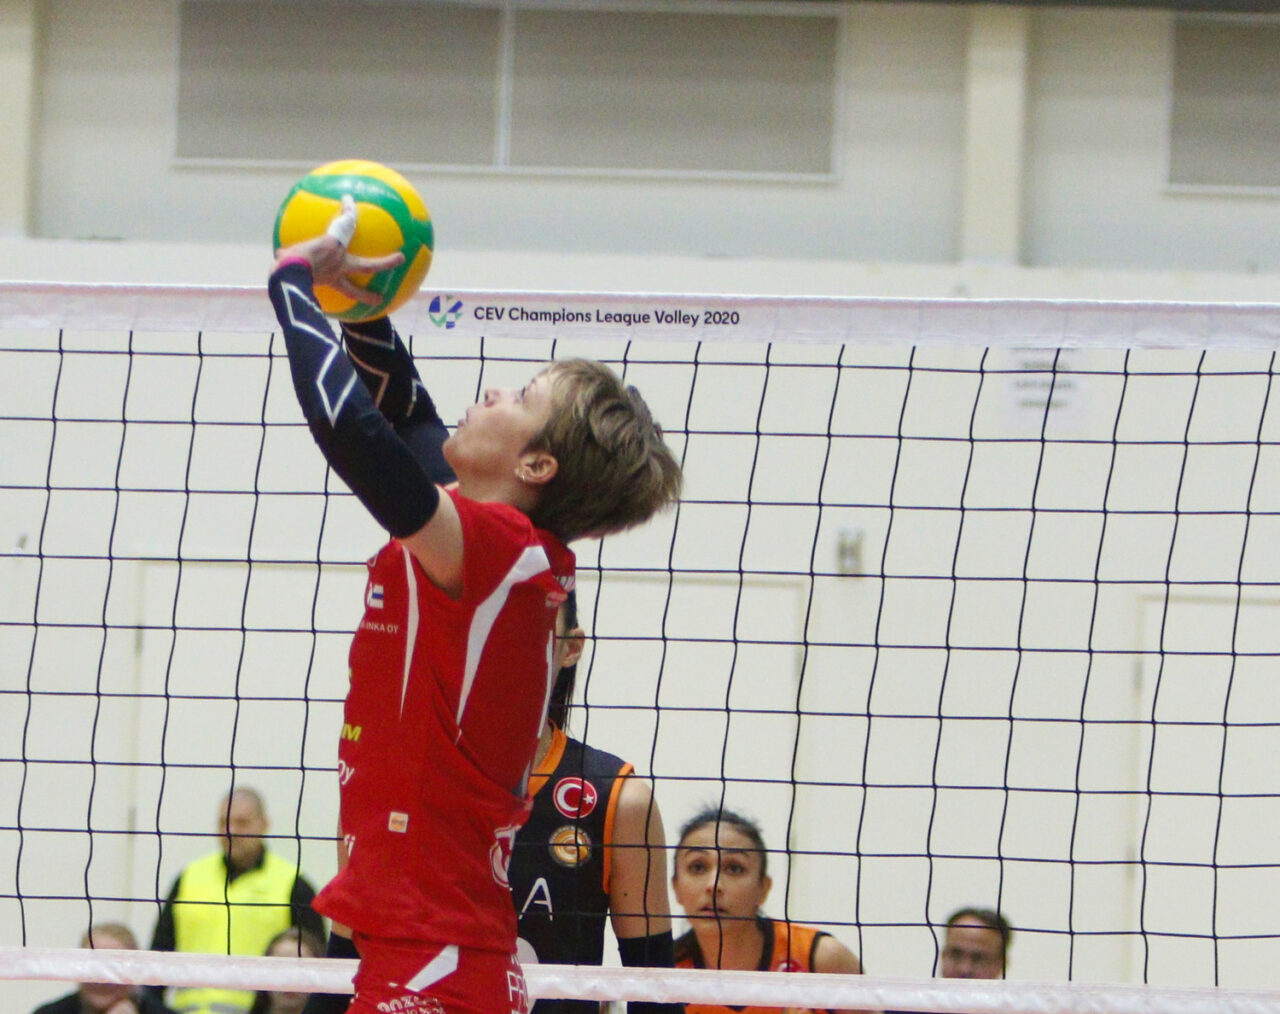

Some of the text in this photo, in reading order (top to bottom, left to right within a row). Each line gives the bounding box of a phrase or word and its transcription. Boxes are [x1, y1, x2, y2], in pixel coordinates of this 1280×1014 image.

[473, 306, 741, 328] CEV Champions League Volley 2020
